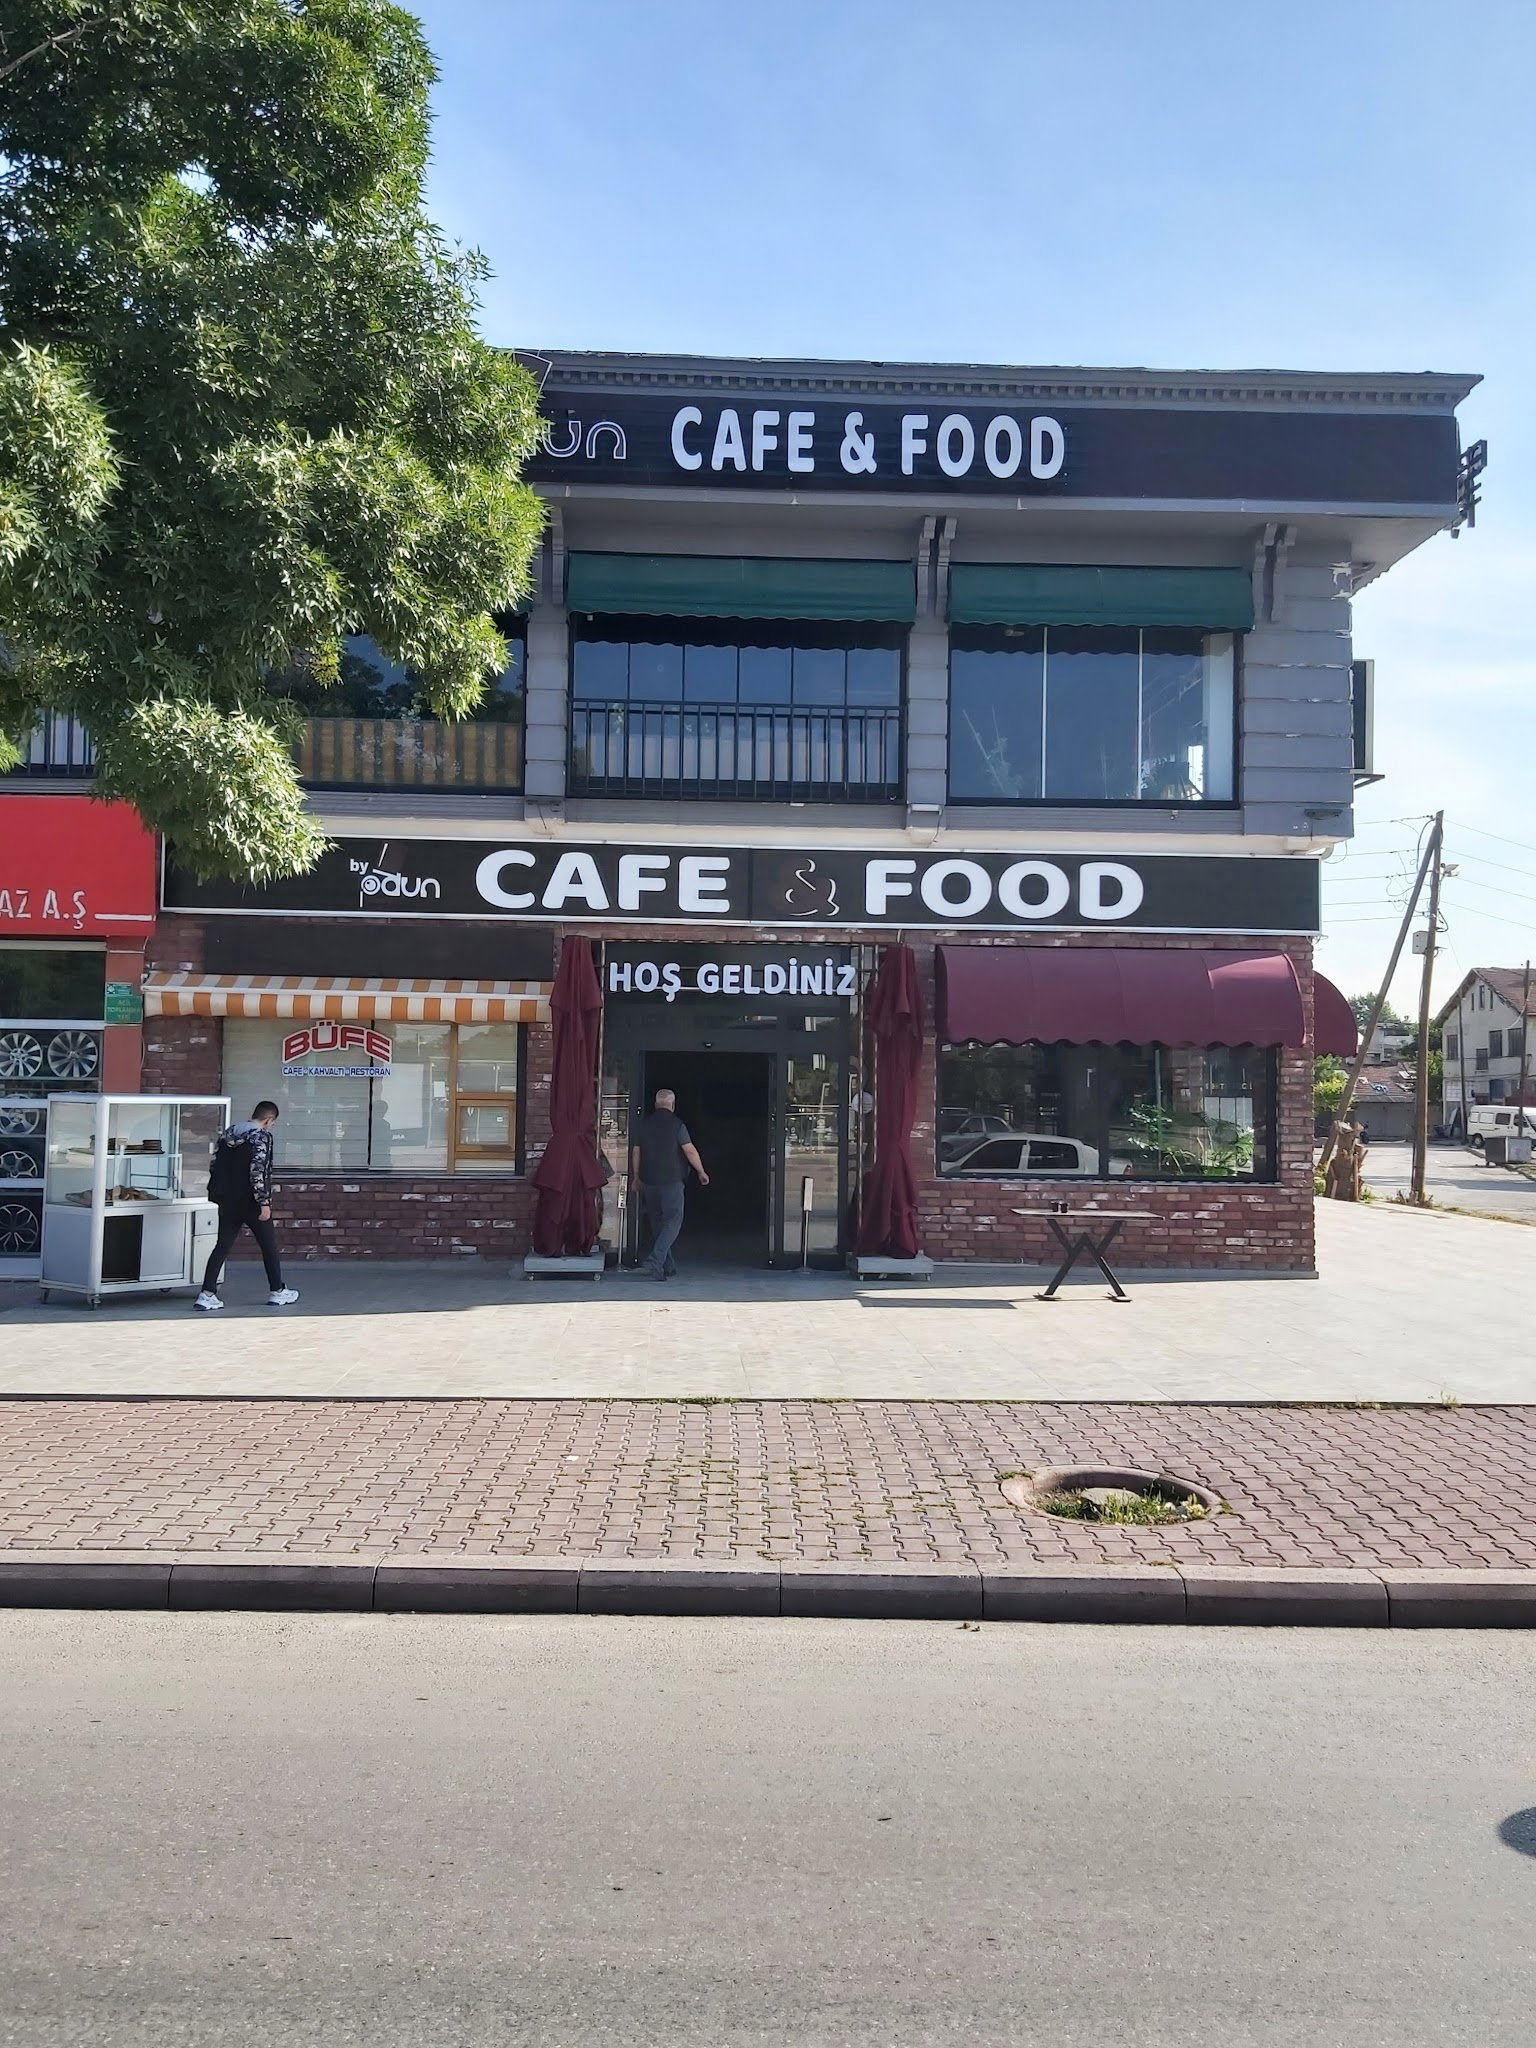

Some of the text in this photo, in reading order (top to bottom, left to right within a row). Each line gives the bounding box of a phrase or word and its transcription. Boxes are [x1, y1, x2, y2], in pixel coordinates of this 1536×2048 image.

[671, 406, 815, 474] CAFE
[840, 411, 877, 474] &
[902, 413, 1065, 479] FOOD
[350, 858, 369, 875] by
[475, 849, 731, 913] CAFE
[865, 858, 1144, 921] FOOD
[609, 957, 856, 1002] HOŞ GELDİNİZ
[282, 1020, 392, 1064] BÜFE
[283, 1066, 303, 1076] CAFE
[350, 1066, 391, 1077] RESTORAN
